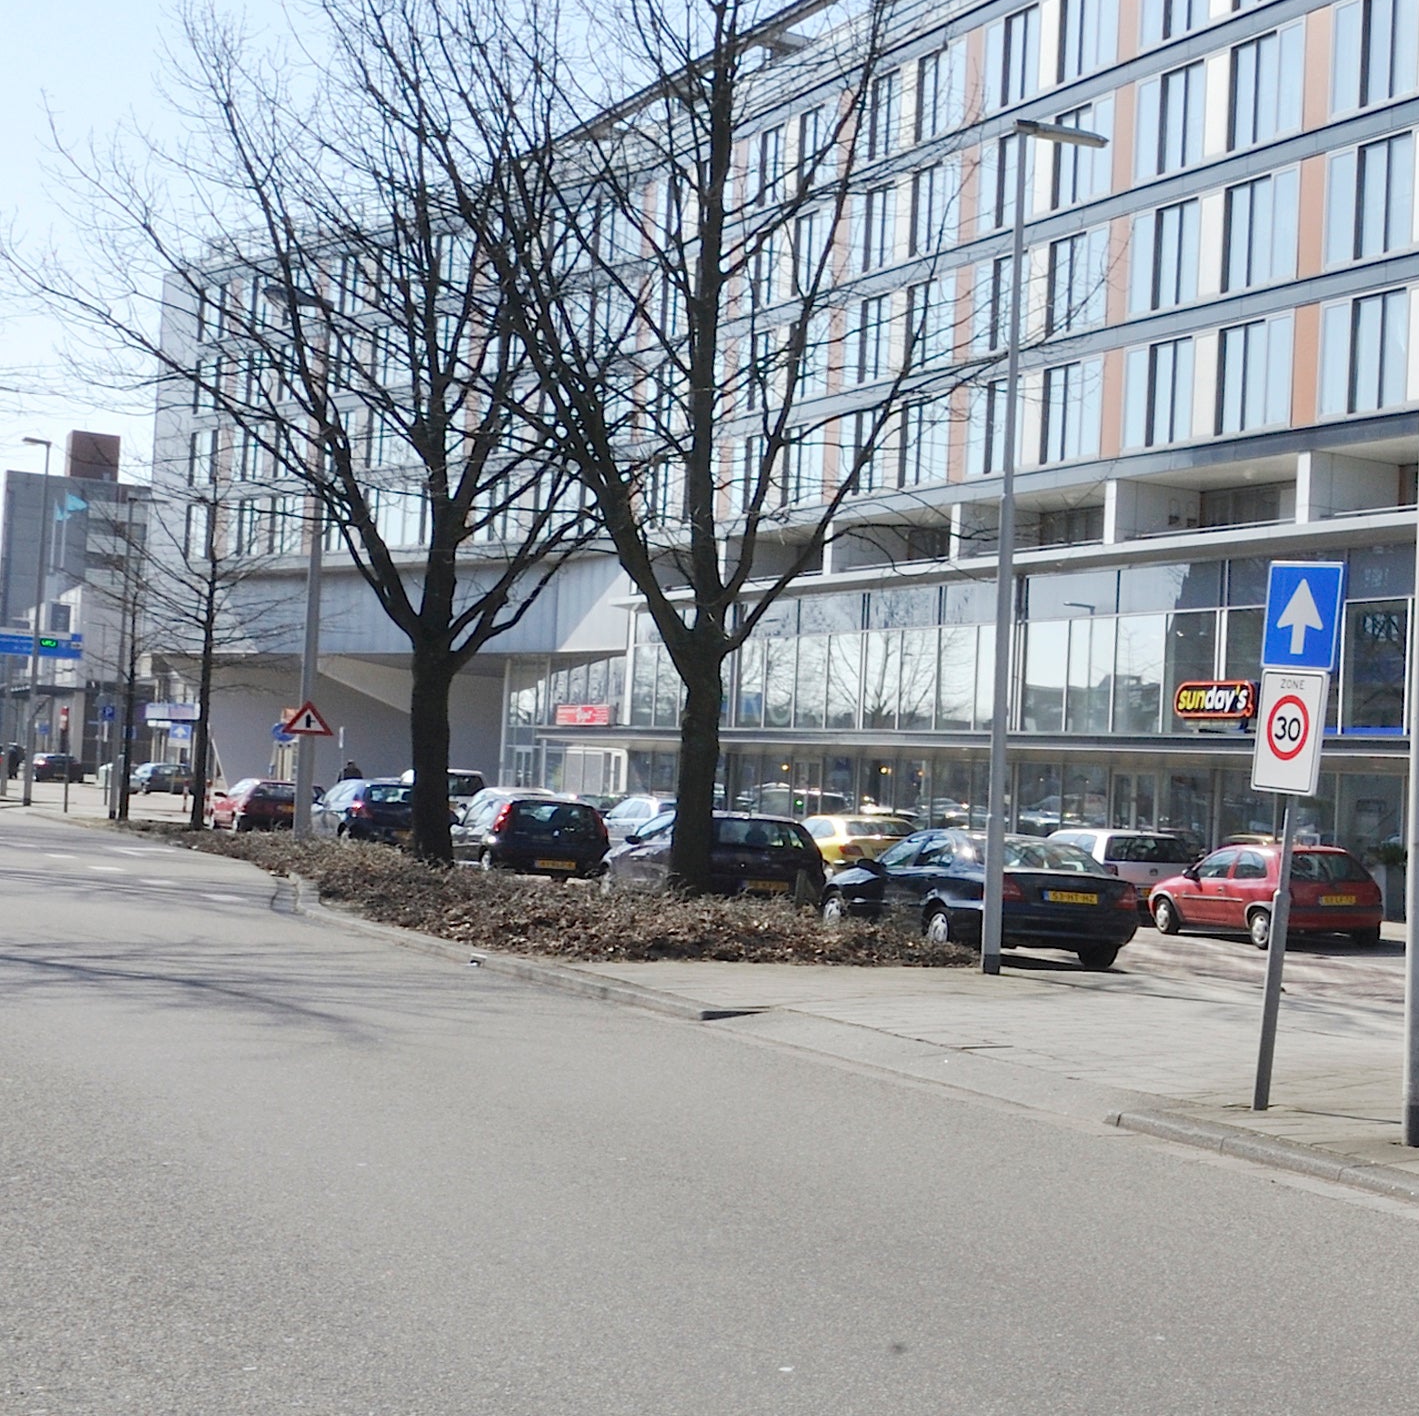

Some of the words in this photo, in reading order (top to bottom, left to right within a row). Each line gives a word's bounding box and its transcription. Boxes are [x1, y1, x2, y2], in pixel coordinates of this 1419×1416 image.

[1280, 678, 1305, 690] ZONE
[1178, 685, 1248, 712] sunday's
[1274, 716, 1301, 742] 30
